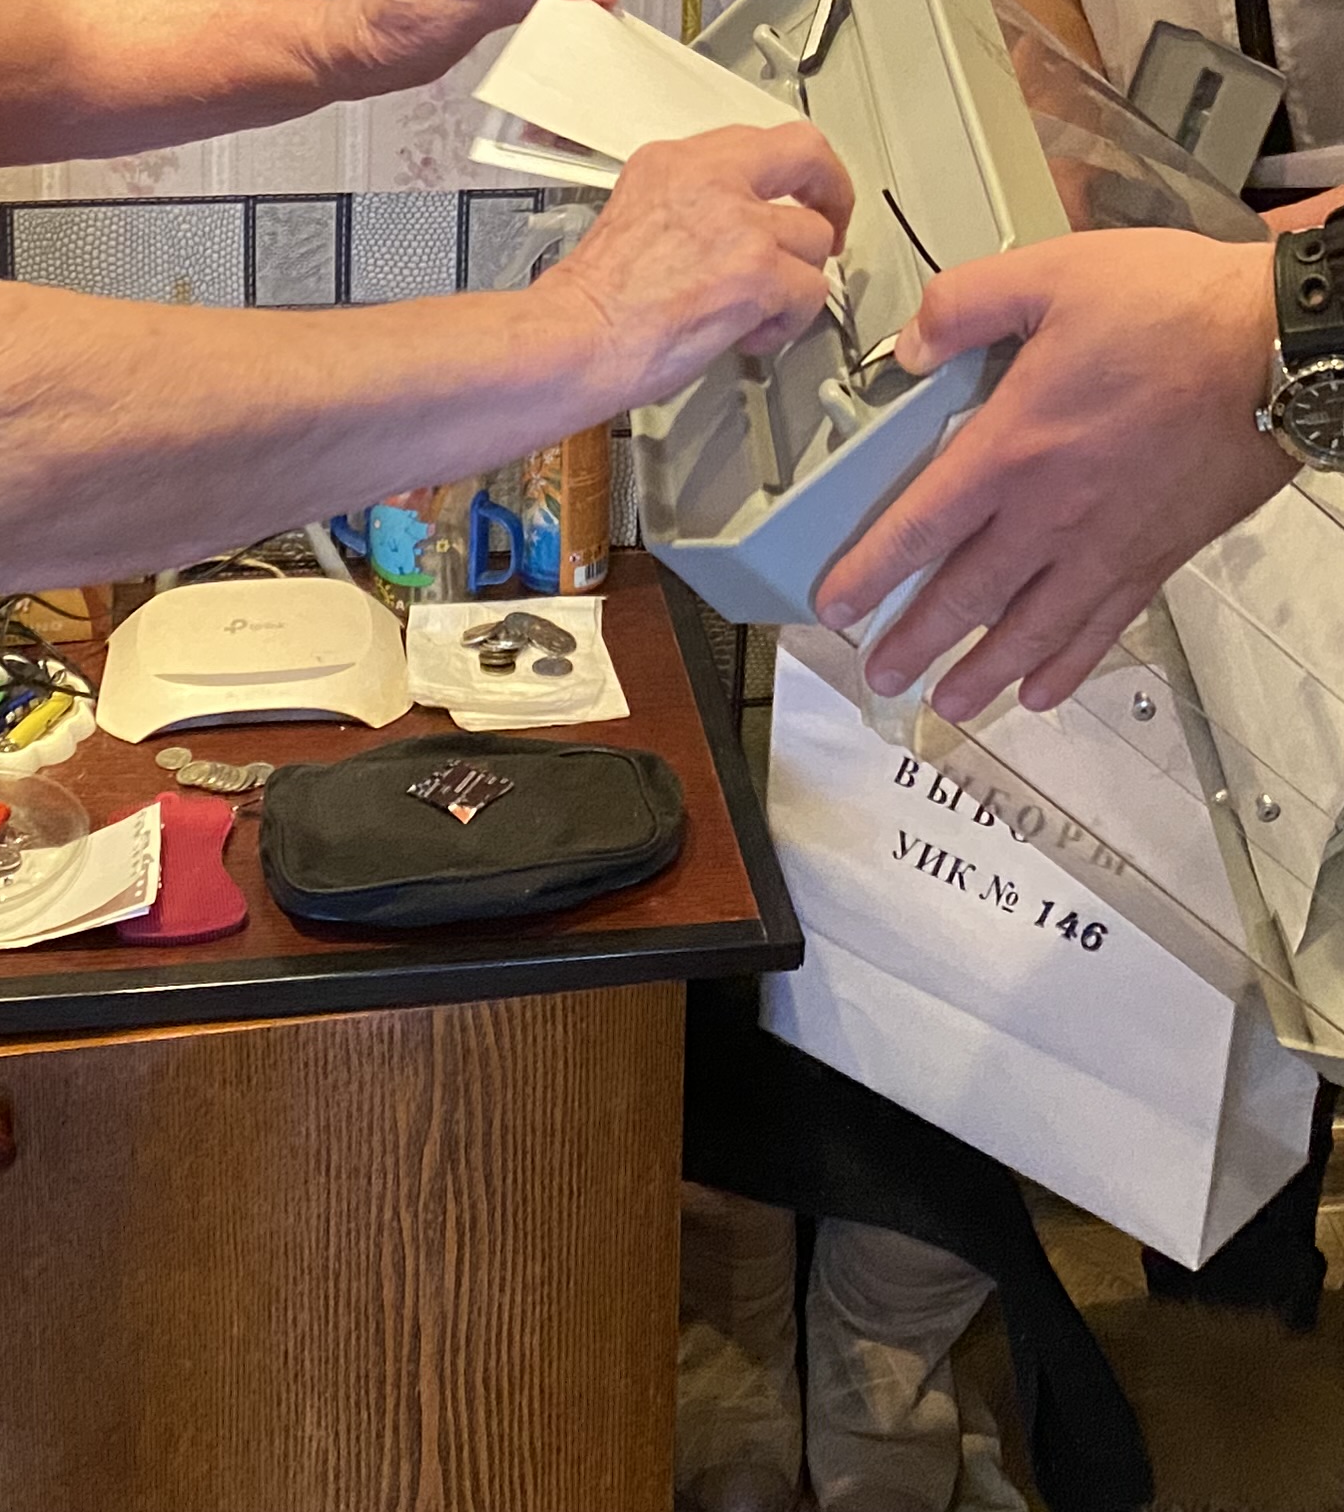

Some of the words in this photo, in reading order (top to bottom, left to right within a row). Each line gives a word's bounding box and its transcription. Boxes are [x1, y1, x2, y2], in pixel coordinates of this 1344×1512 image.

[892, 830, 976, 891] УИК
[979, 874, 1020, 913] №
[1034, 899, 1109, 952] 146
